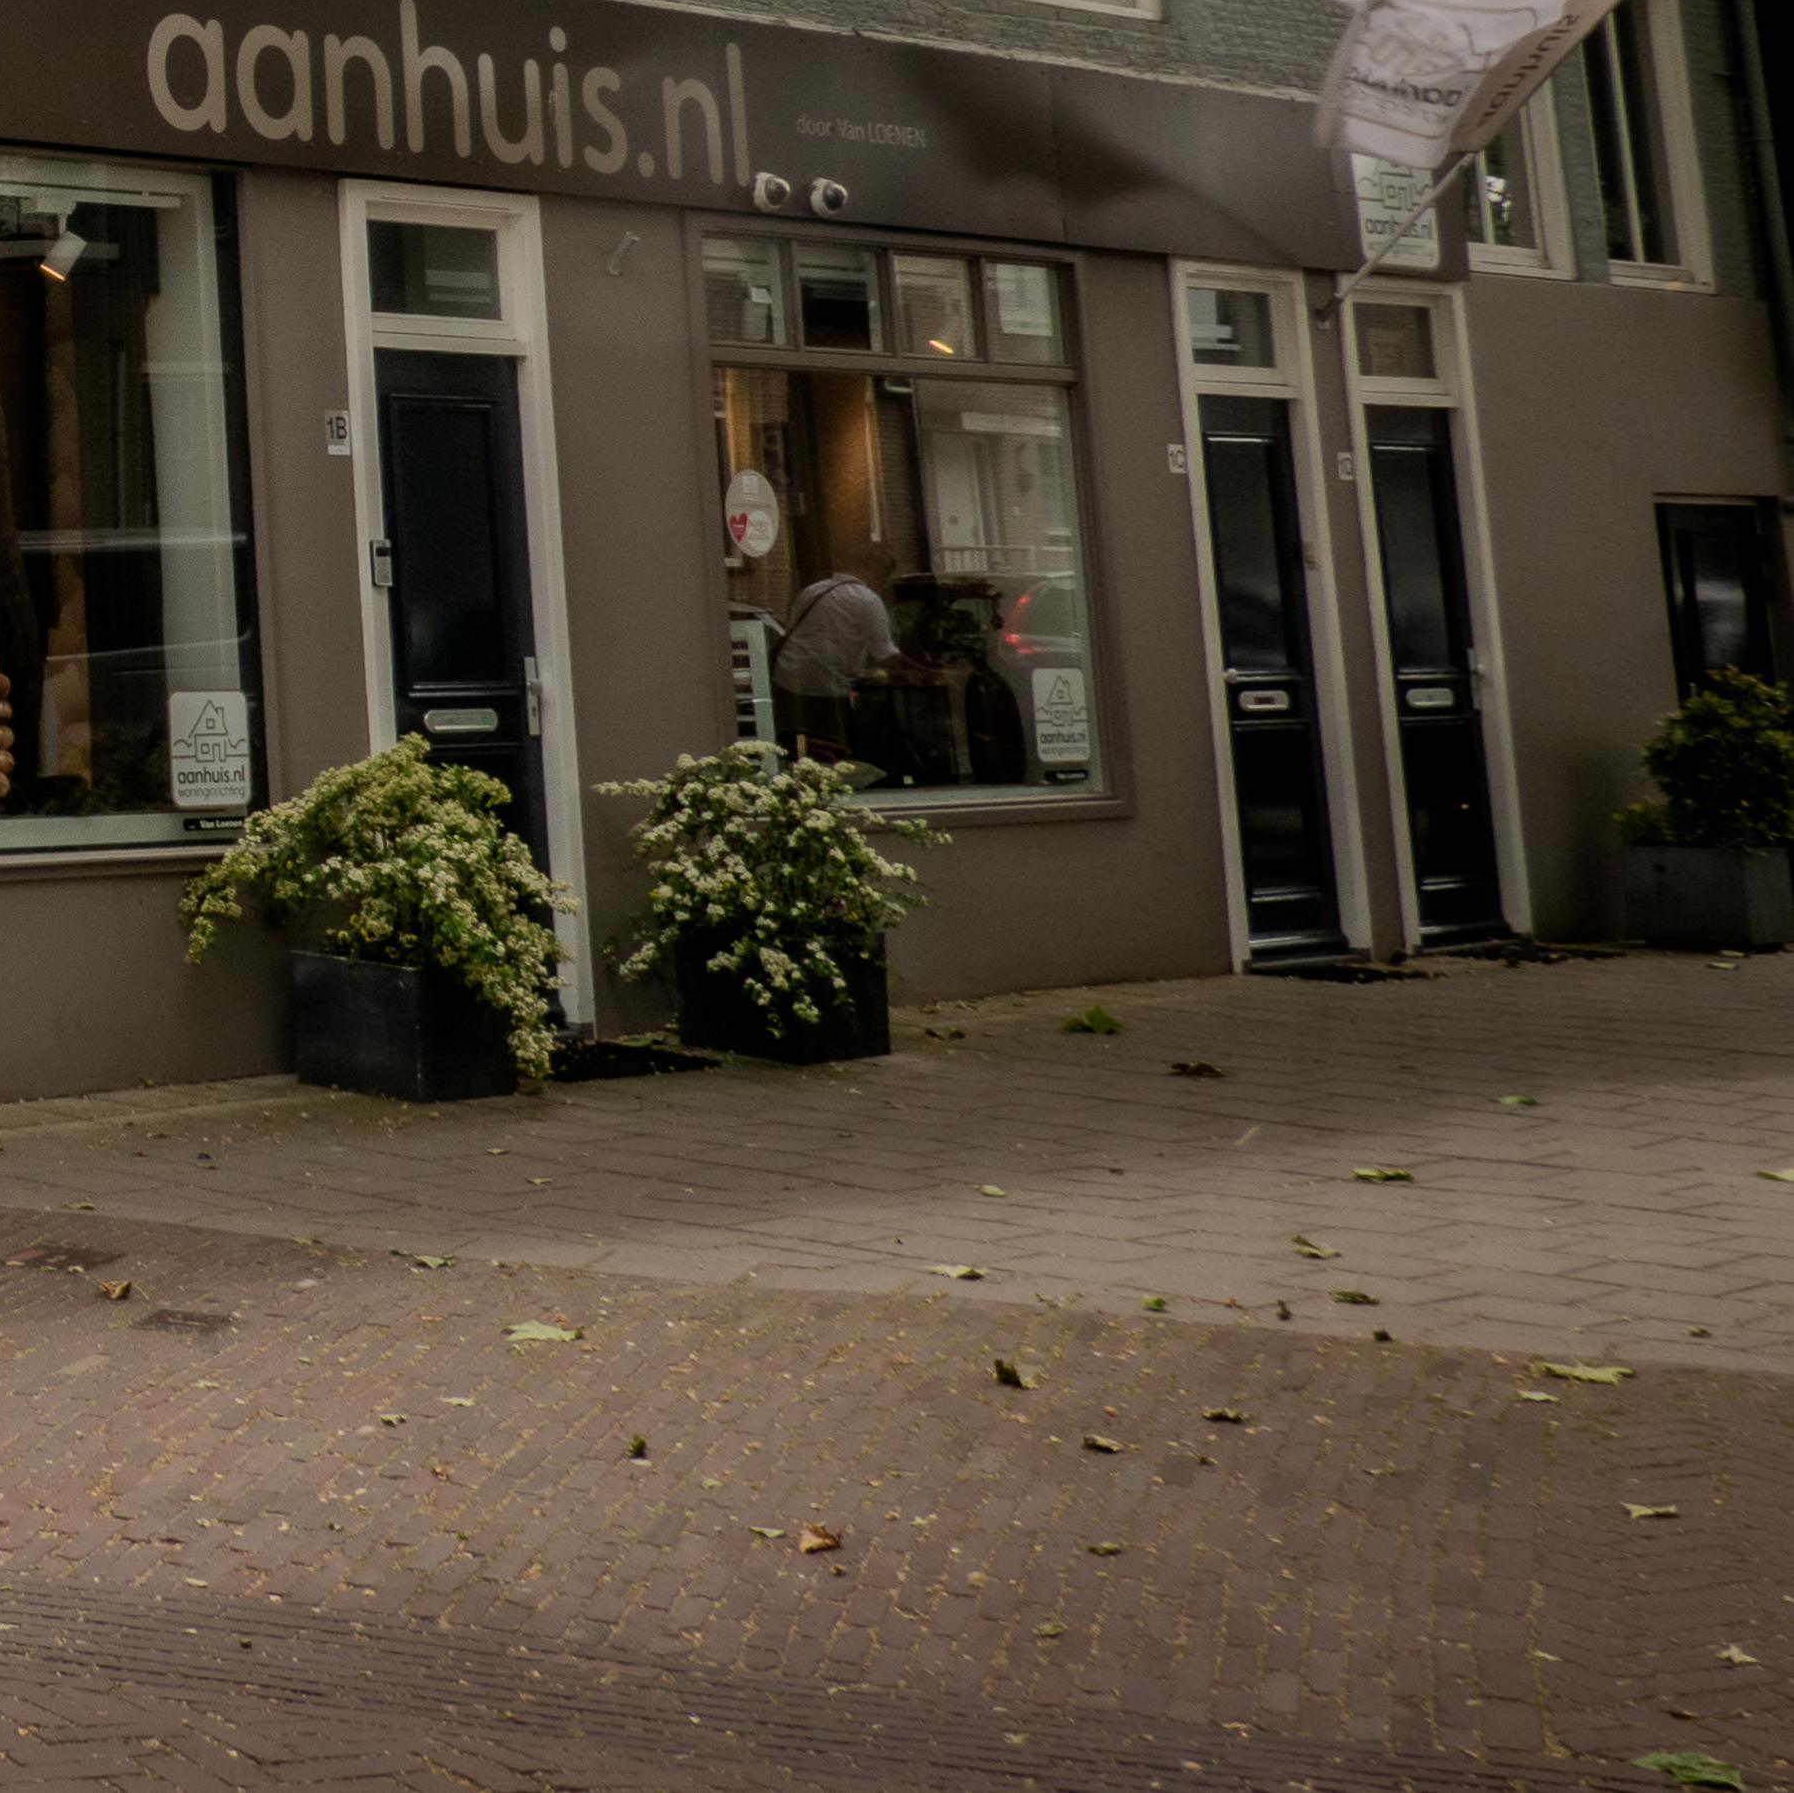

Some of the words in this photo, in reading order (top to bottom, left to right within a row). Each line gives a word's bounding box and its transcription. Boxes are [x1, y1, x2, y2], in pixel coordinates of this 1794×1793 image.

[796, 114, 830, 139] door
[837, 119, 866, 142] Van
[867, 121, 926, 149] LOENEN
[327, 416, 348, 439] 1B
[177, 765, 245, 784] aanhuis.nl
